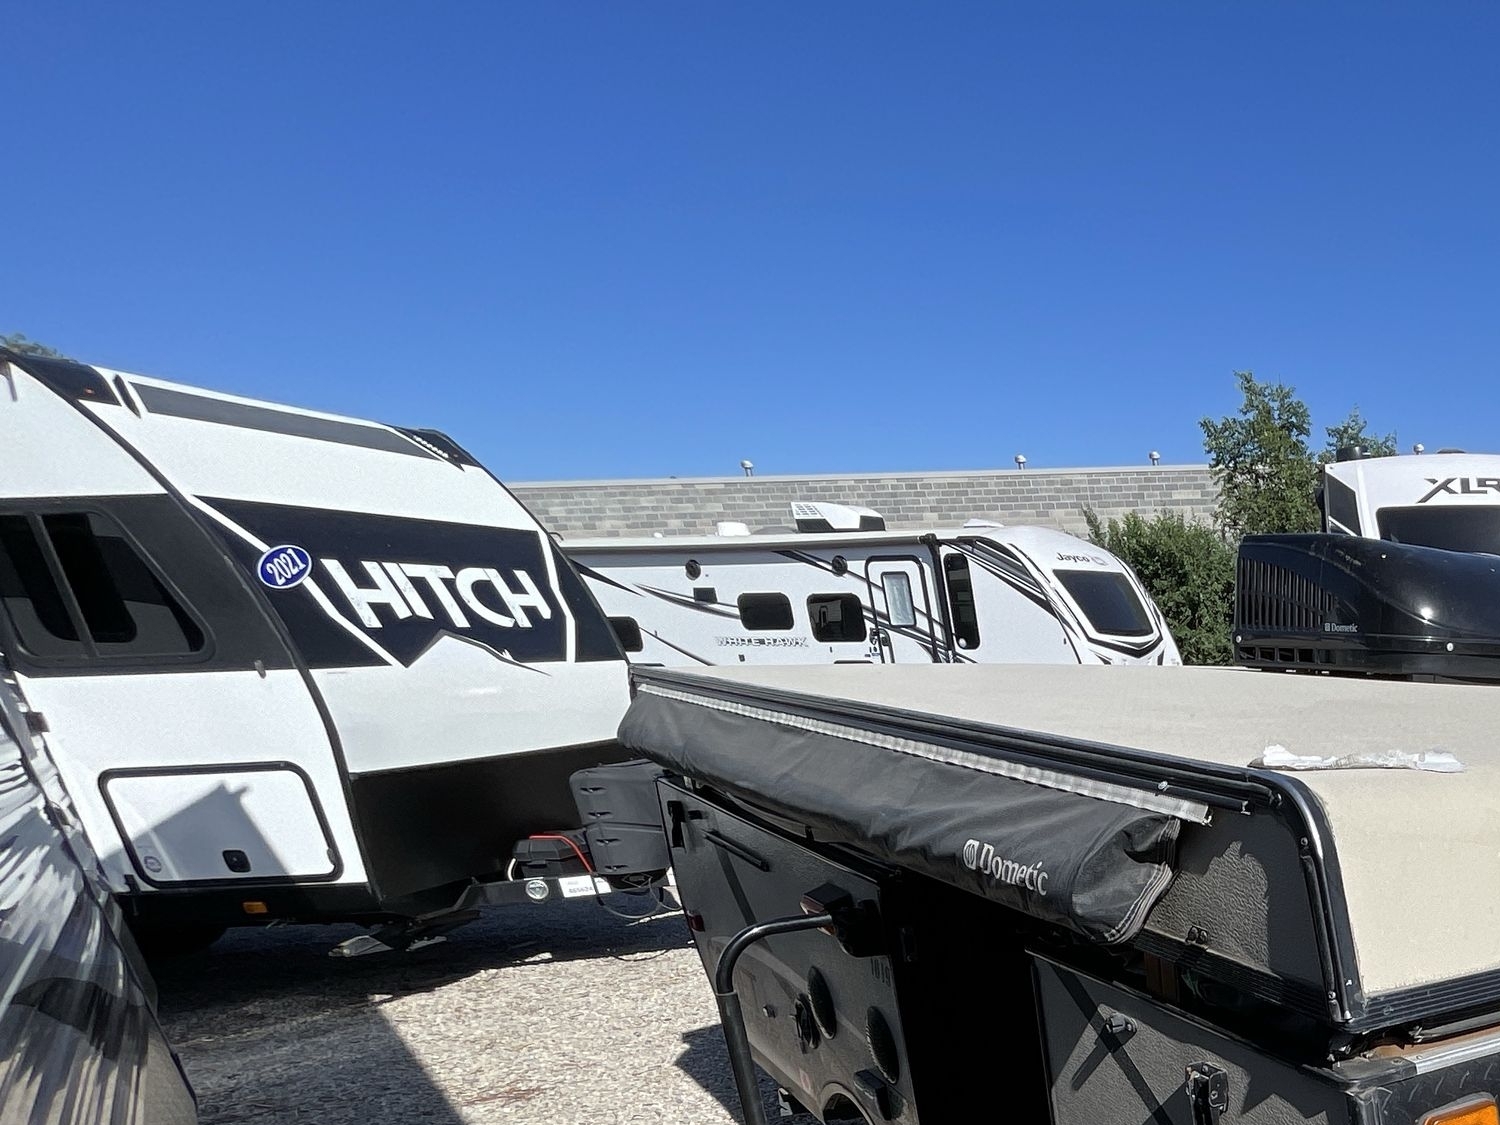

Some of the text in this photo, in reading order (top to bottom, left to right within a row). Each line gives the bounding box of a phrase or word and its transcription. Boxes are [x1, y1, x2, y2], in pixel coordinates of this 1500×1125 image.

[266, 548, 306, 585] 2021
[1056, 552, 1091, 563] Jayco
[319, 558, 551, 628] HITCH
[1331, 622, 1358, 632] Dometic
[716, 636, 809, 647] WHITE HAWK
[980, 843, 1048, 896] Dometic
